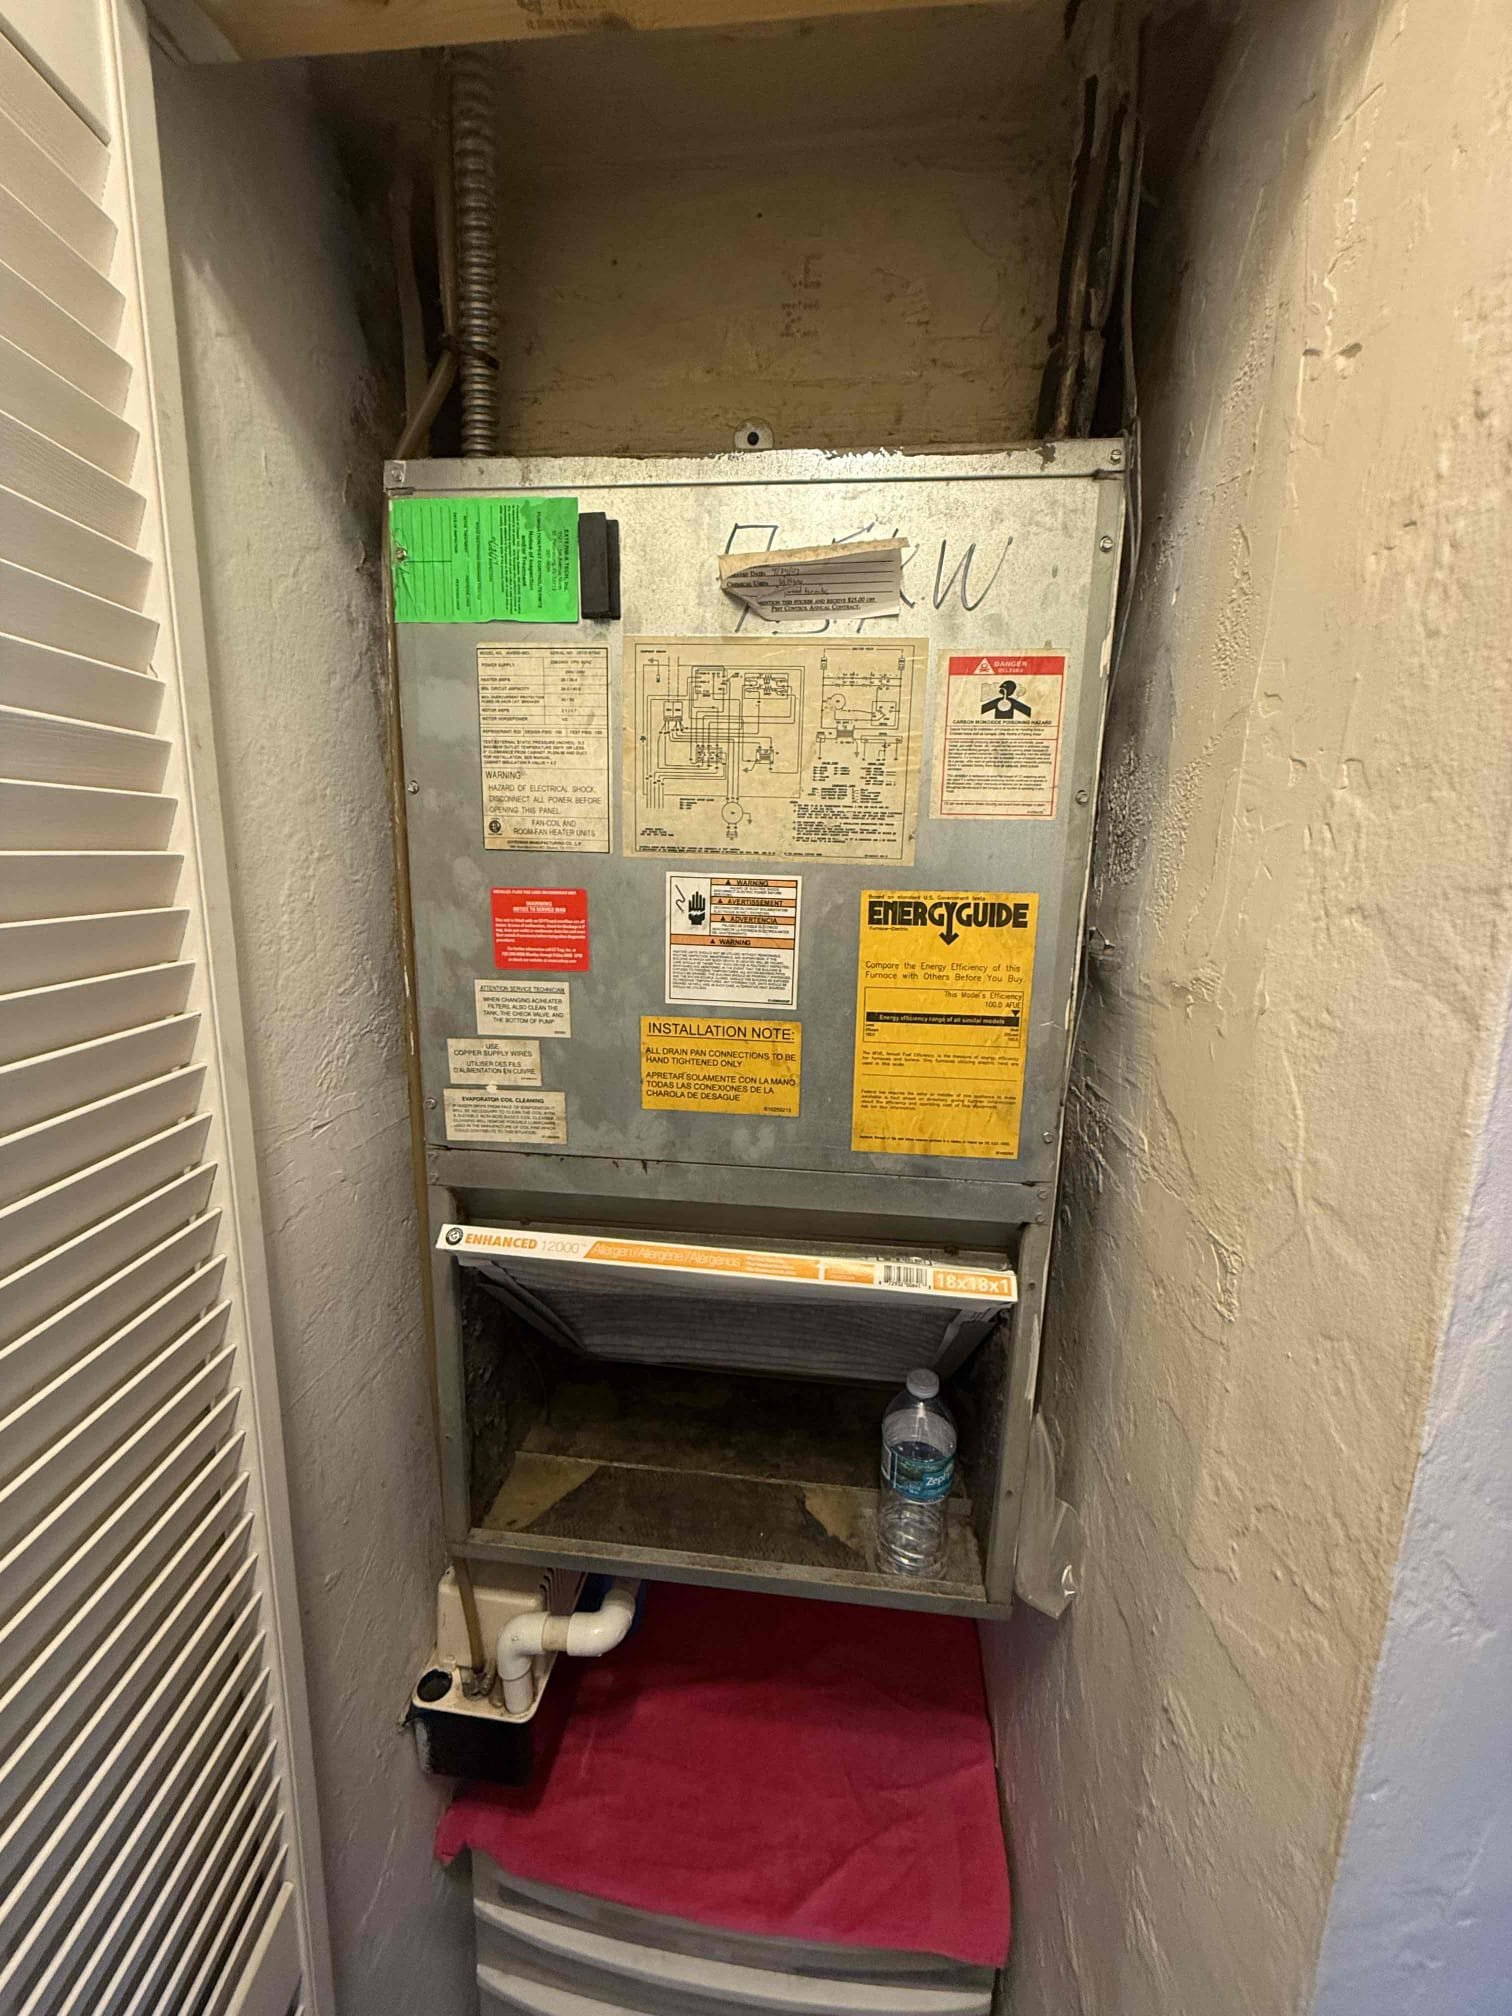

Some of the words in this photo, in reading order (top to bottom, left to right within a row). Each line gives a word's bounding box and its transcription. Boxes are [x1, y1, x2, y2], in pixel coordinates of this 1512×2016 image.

[866, 961, 899, 971] Compare
[904, 962, 916, 970] the
[921, 962, 947, 972] Energy
[951, 963, 988, 973] Efficiency
[992, 964, 1001, 972] of
[1006, 964, 1020, 972] this
[648, 1022, 747, 1038] INSTALLATION
[751, 1028, 795, 1040] NOTE:
[708, 1050, 769, 1060] CONNECTIONS
[672, 1058, 718, 1066] TIGHTENED
[686, 1073, 736, 1083] SOLAMENTE
[694, 1083, 748, 1093] CONEXIONES
[646, 1090, 685, 1098] CHAROLA
[464, 1233, 537, 1249] ENHANCED
[937, 1274, 1009, 1294] 18x18x1
